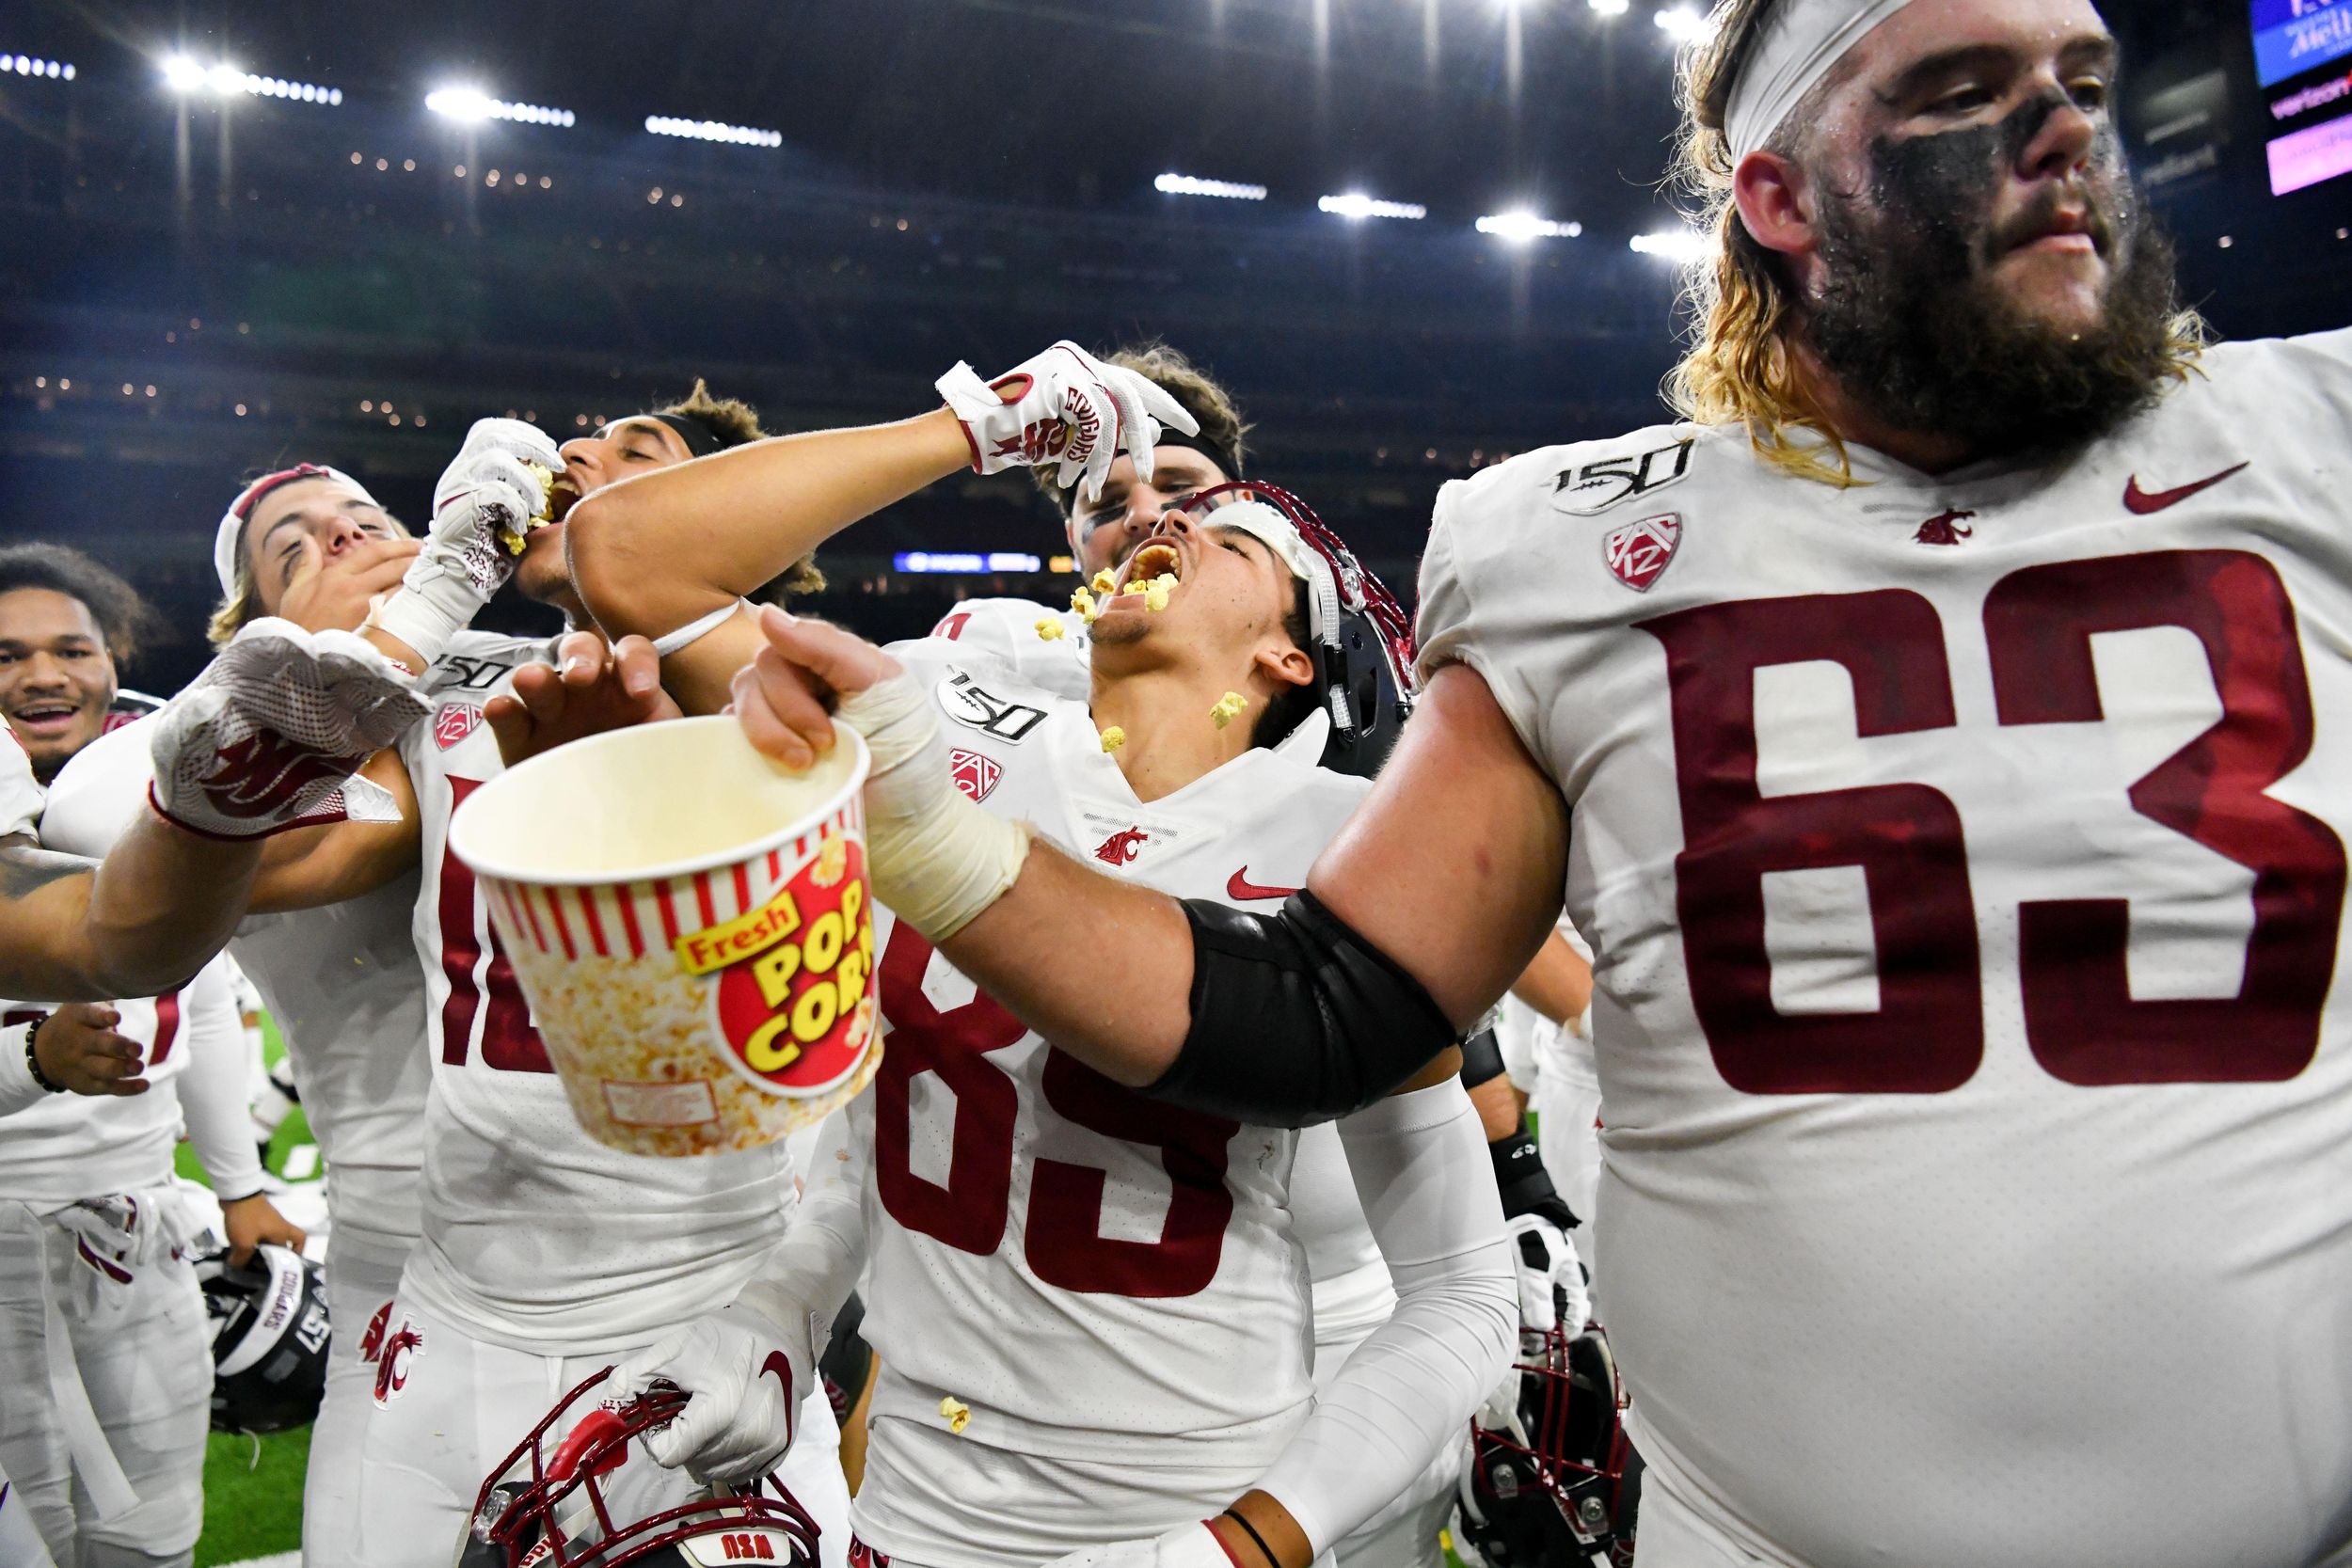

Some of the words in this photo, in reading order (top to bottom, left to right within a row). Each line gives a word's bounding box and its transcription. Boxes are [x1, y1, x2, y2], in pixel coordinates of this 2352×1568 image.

[1065, 386, 1100, 464] COUGARS
[1552, 439, 1695, 510] 150
[1604, 513, 1679, 568] PAC
[1623, 544, 1664, 578] 12
[431, 654, 514, 689] 150
[439, 721, 467, 740] 12
[948, 671, 1049, 741] 150
[1629, 548, 2349, 1095] 63
[686, 906, 791, 968] Fresh
[753, 879, 864, 1010] POP
[721, 1533, 776, 1560] WSU
